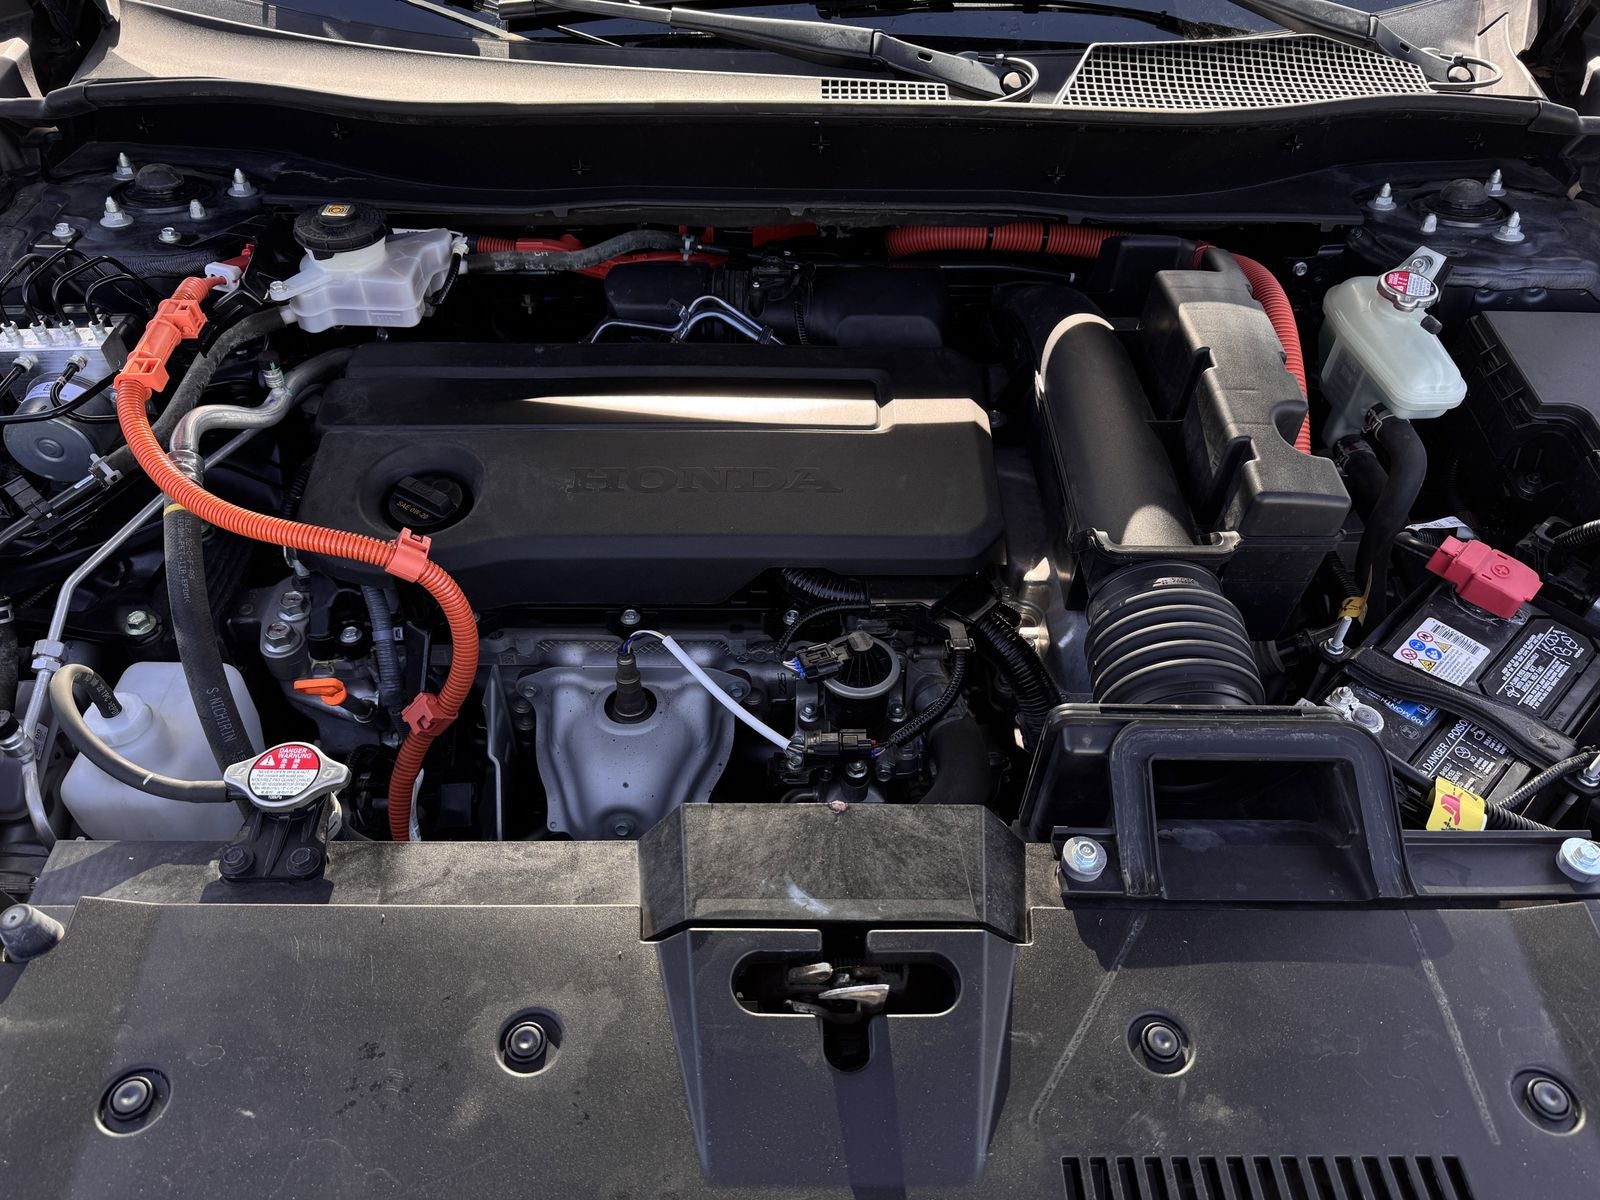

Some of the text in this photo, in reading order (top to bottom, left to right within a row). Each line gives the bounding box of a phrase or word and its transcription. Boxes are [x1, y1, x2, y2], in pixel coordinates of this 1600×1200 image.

[566, 465, 843, 494] HONDA
[397, 500, 410, 512] SAE
[1380, 698, 1410, 717] MONTH
[1411, 716, 1424, 726] 100
[1422, 742, 1449, 770] DANGER
[1448, 720, 1468, 740] POISO
